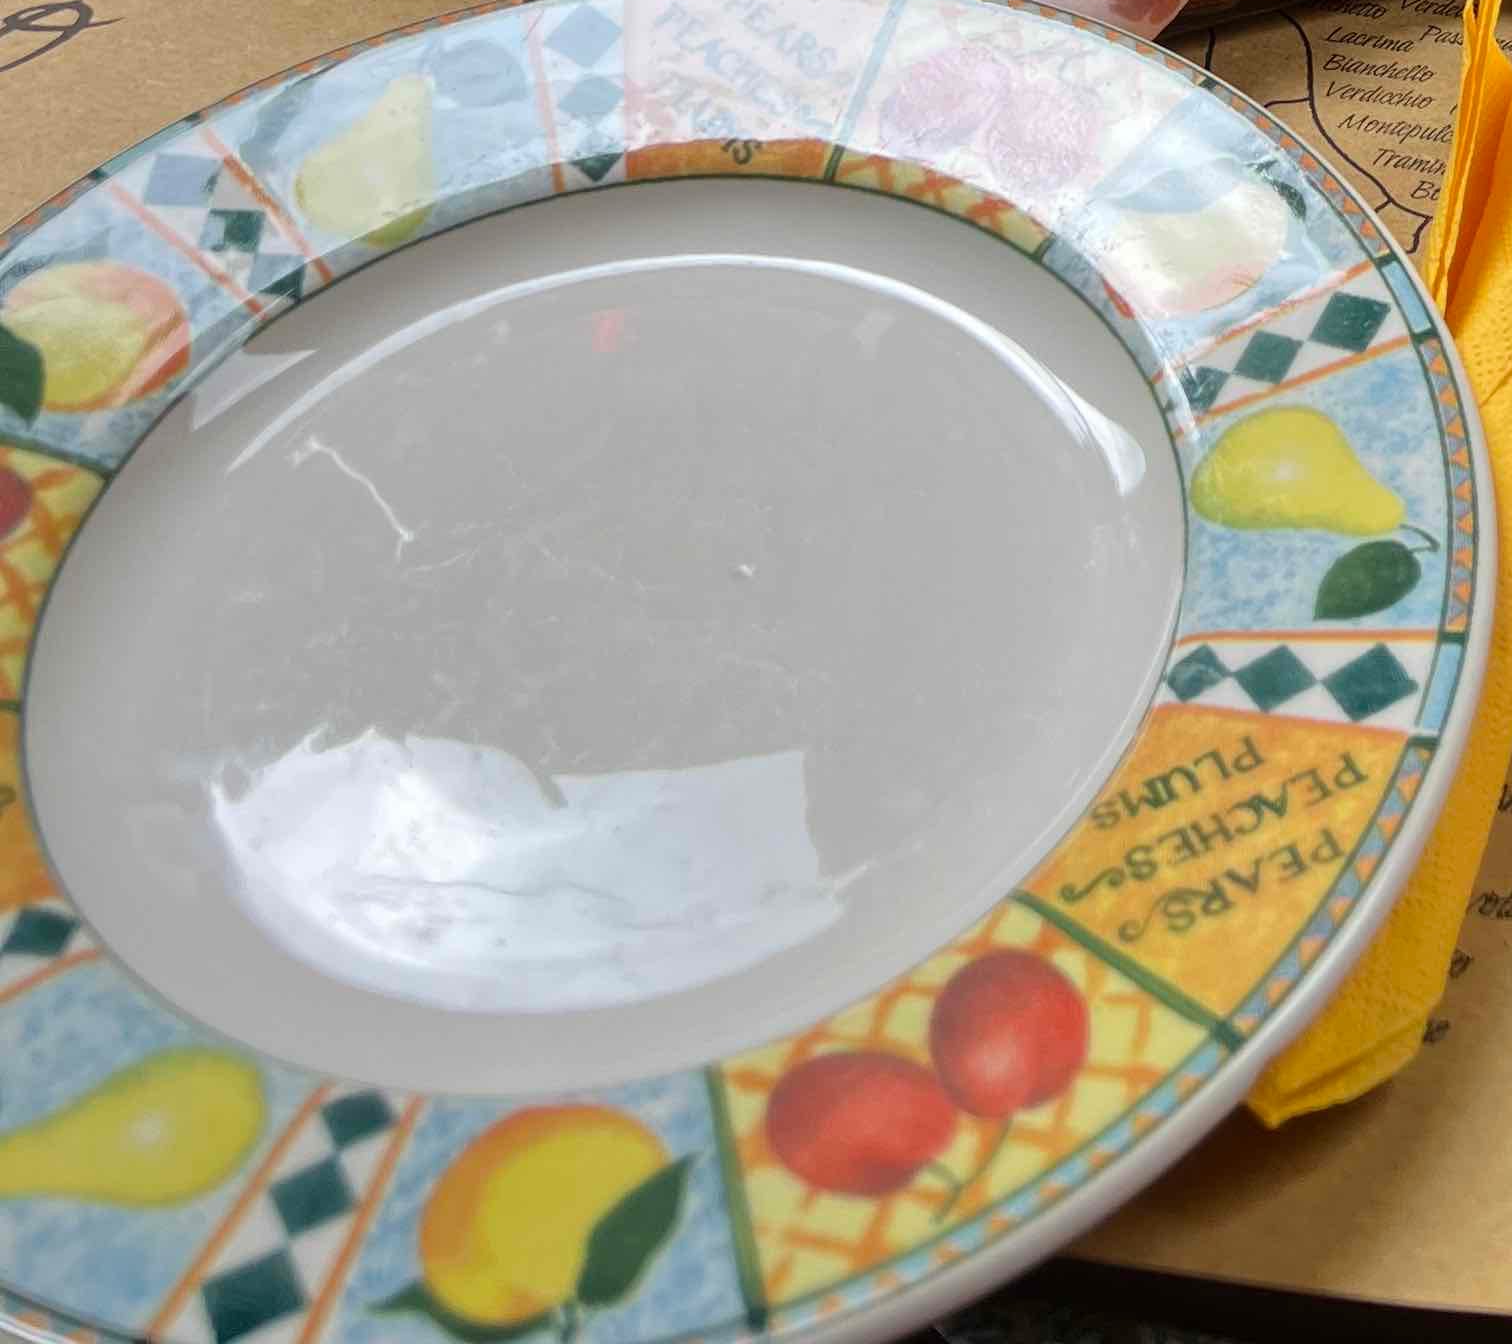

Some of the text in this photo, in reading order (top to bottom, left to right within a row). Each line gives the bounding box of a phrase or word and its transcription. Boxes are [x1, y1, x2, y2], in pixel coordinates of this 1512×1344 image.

[1323, 55, 1438, 82] Bianchello
[1325, 26, 1416, 53] Lacrima
[1326, 82, 1435, 109] Verdicchio
[1089, 734, 1266, 831] PLUMS
[1110, 751, 1369, 887] PEACHES
[1155, 827, 1345, 936] PEARS
